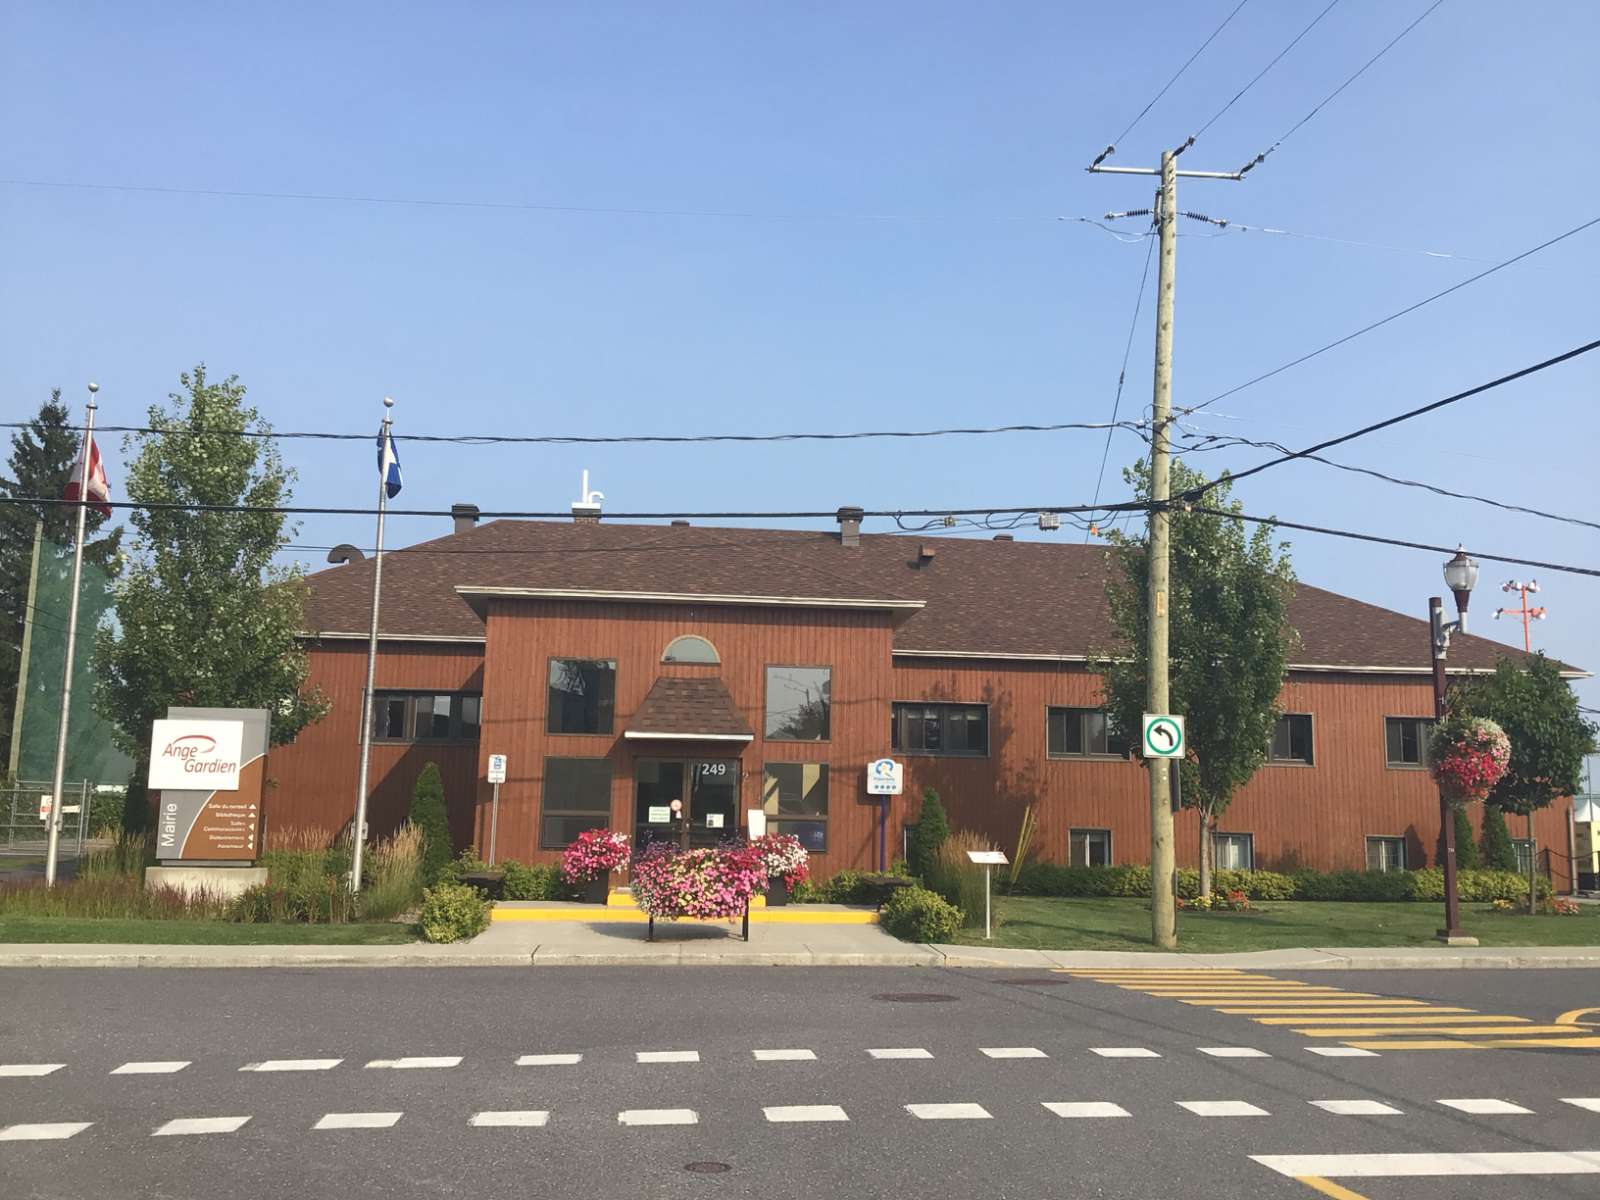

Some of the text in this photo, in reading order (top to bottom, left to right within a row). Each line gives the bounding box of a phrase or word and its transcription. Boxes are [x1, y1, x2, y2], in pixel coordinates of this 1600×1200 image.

[162, 743, 198, 760] Ange
[184, 758, 237, 774] Gardien
[702, 763, 726, 776] 249
[161, 803, 177, 847] Mairie
